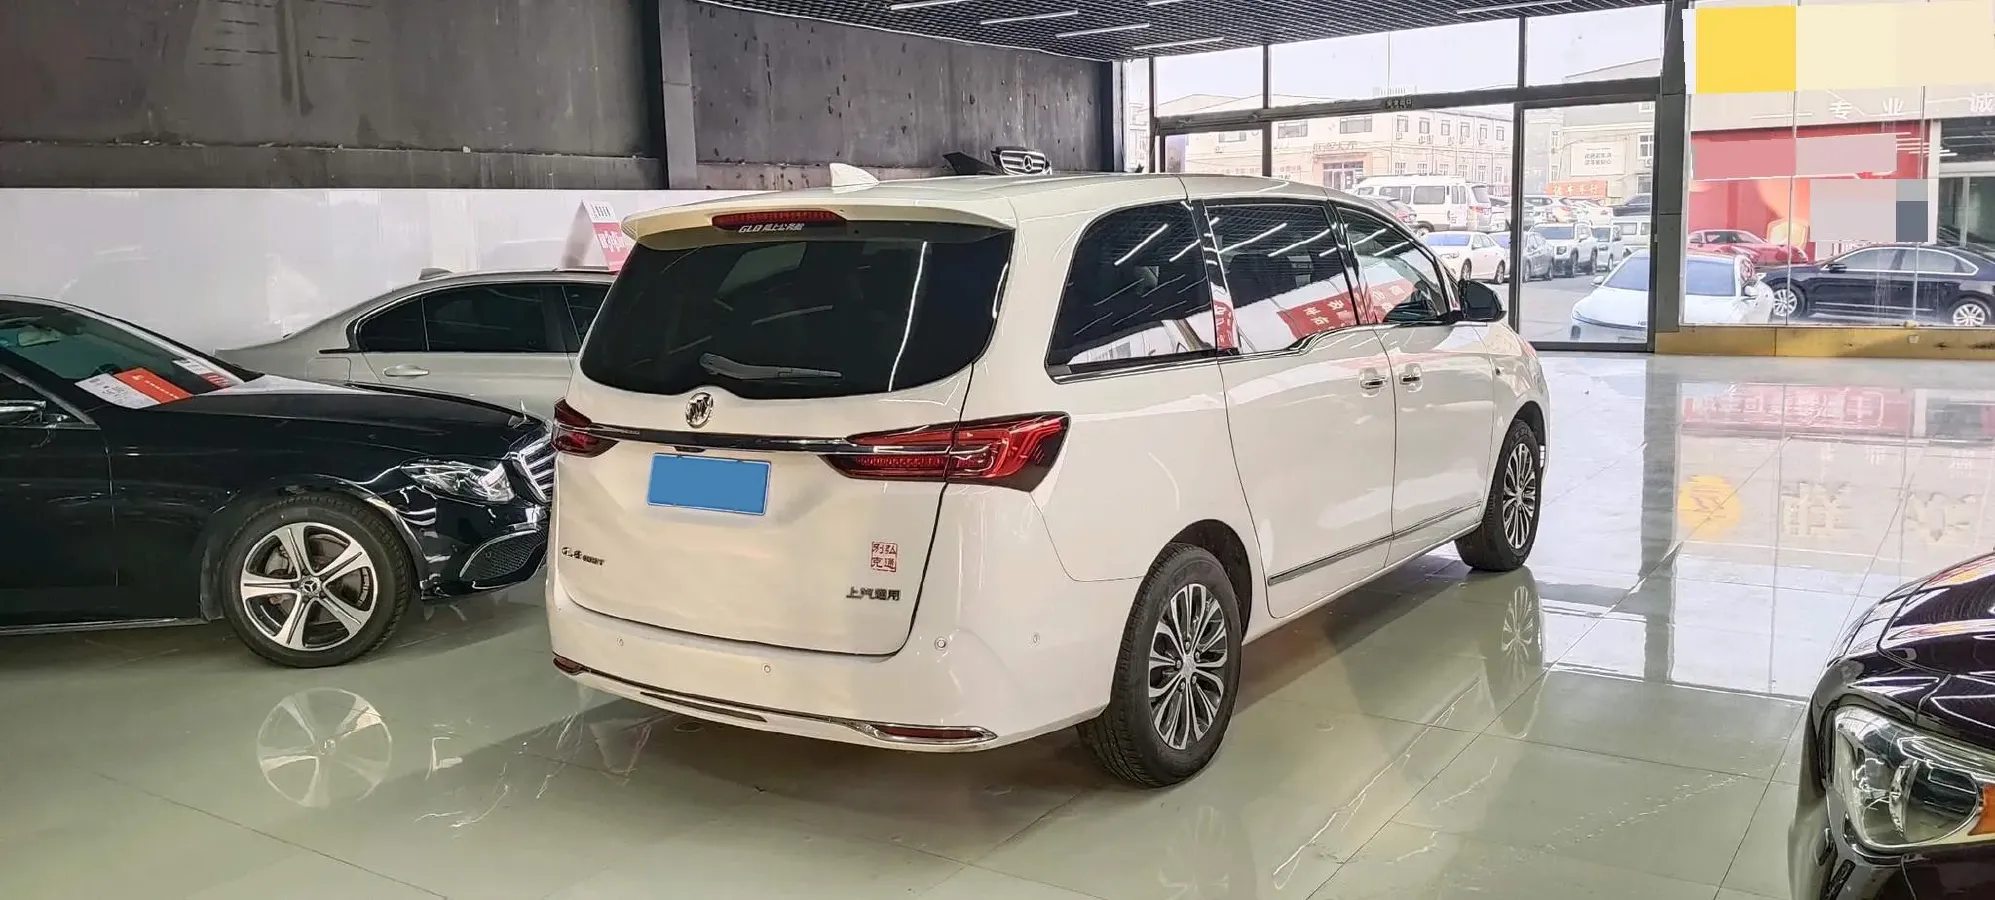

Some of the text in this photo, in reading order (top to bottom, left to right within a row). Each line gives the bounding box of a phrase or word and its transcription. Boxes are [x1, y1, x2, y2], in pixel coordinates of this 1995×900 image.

[1829, 92, 1995, 120] 专业 诚
[846, 586, 900, 601] 上汽通用
